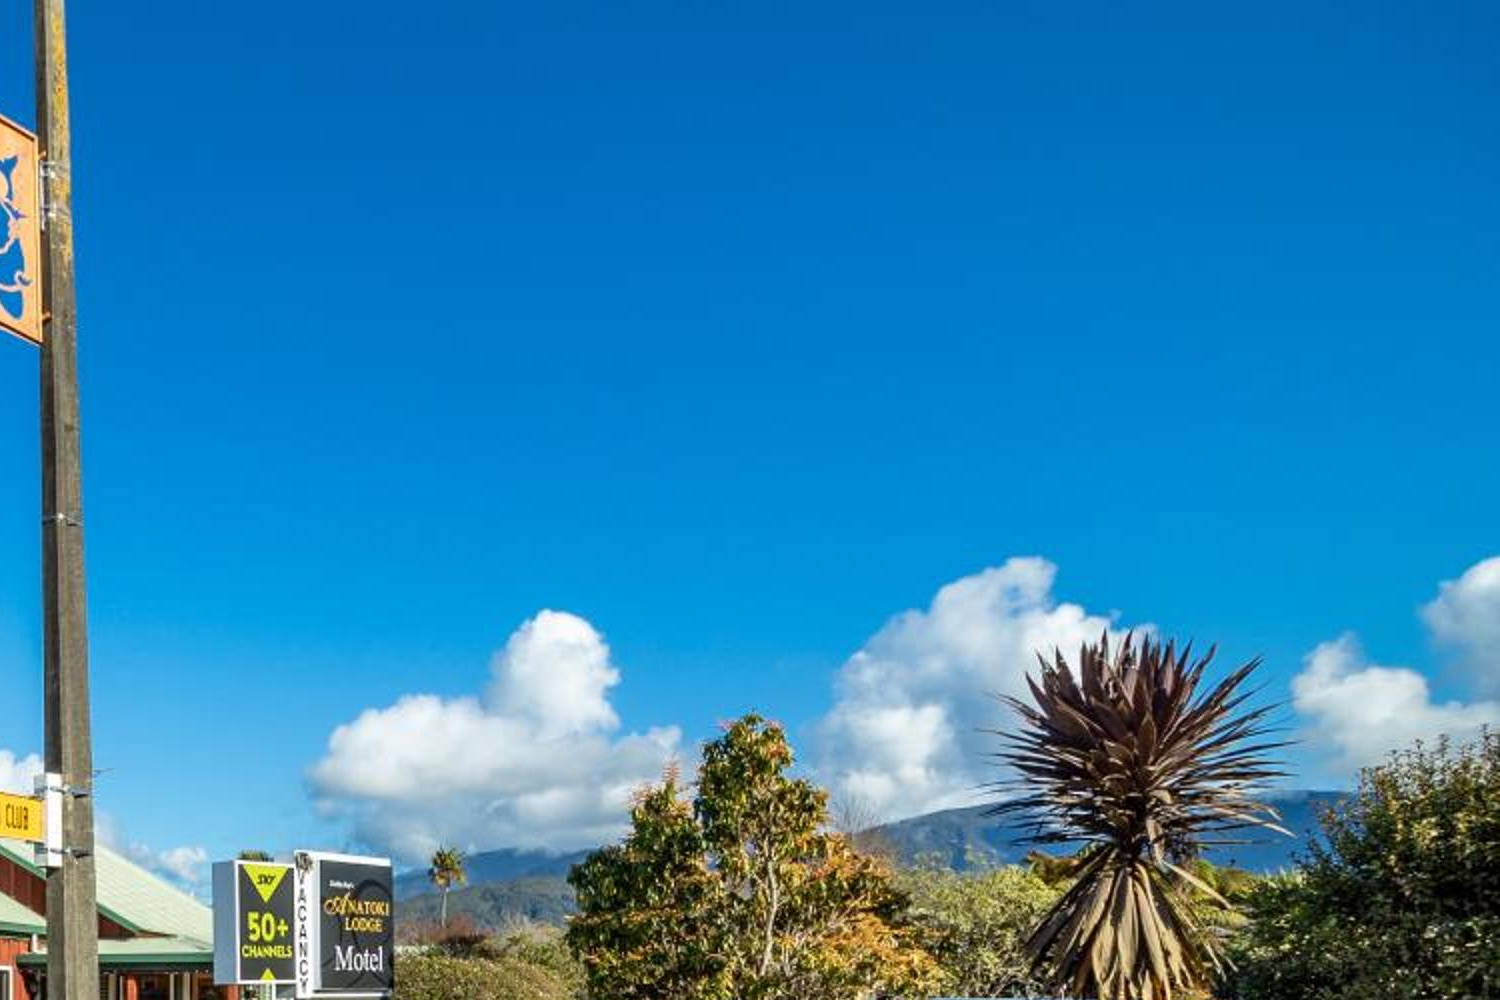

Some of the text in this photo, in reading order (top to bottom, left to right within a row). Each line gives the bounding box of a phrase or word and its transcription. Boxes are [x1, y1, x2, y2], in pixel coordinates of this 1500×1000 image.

[5, 802, 29, 830] CLUB
[247, 911, 289, 942] 50+
[345, 917, 383, 933] LODGE
[242, 944, 293, 959] CHANNELS
[334, 945, 384, 972] Motel
